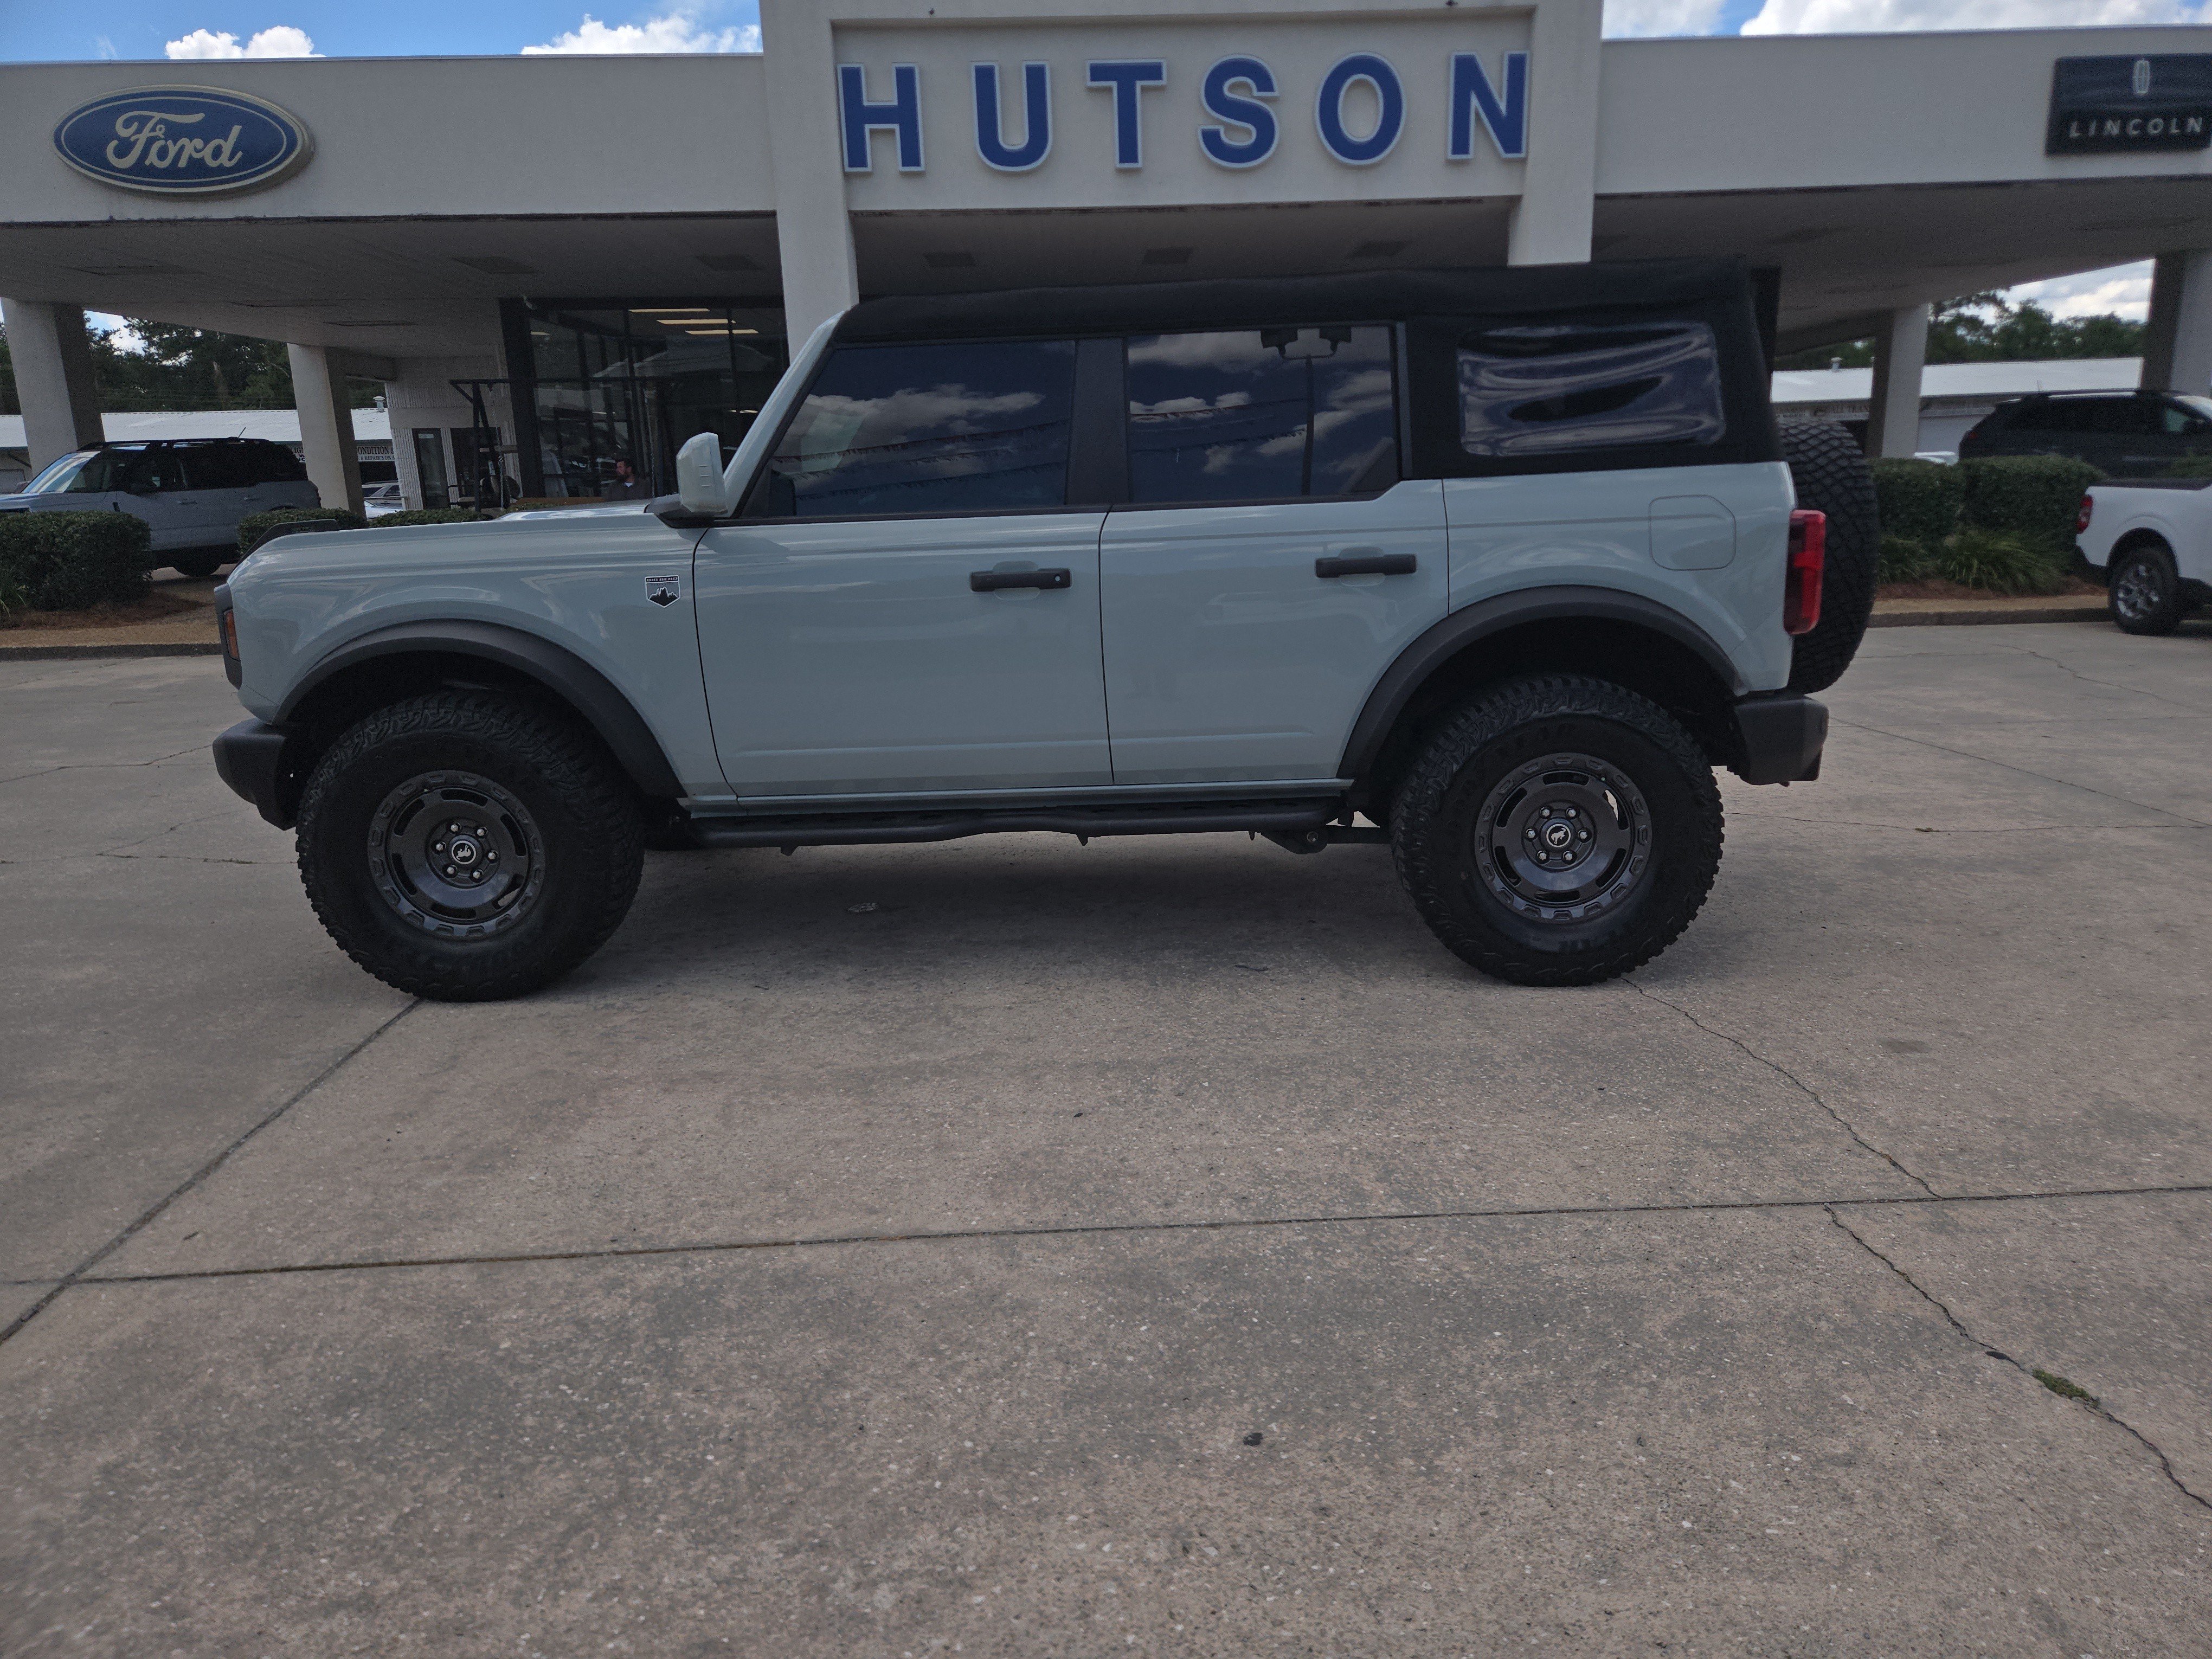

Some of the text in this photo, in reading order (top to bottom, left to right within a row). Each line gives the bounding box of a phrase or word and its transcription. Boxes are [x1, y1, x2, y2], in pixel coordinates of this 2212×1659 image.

[837, 51, 1529, 172] HUTSON
[2069, 117, 2203, 137] LINCOLN
[106, 110, 243, 169] Ford
[358, 446, 389, 454] ONDITION
